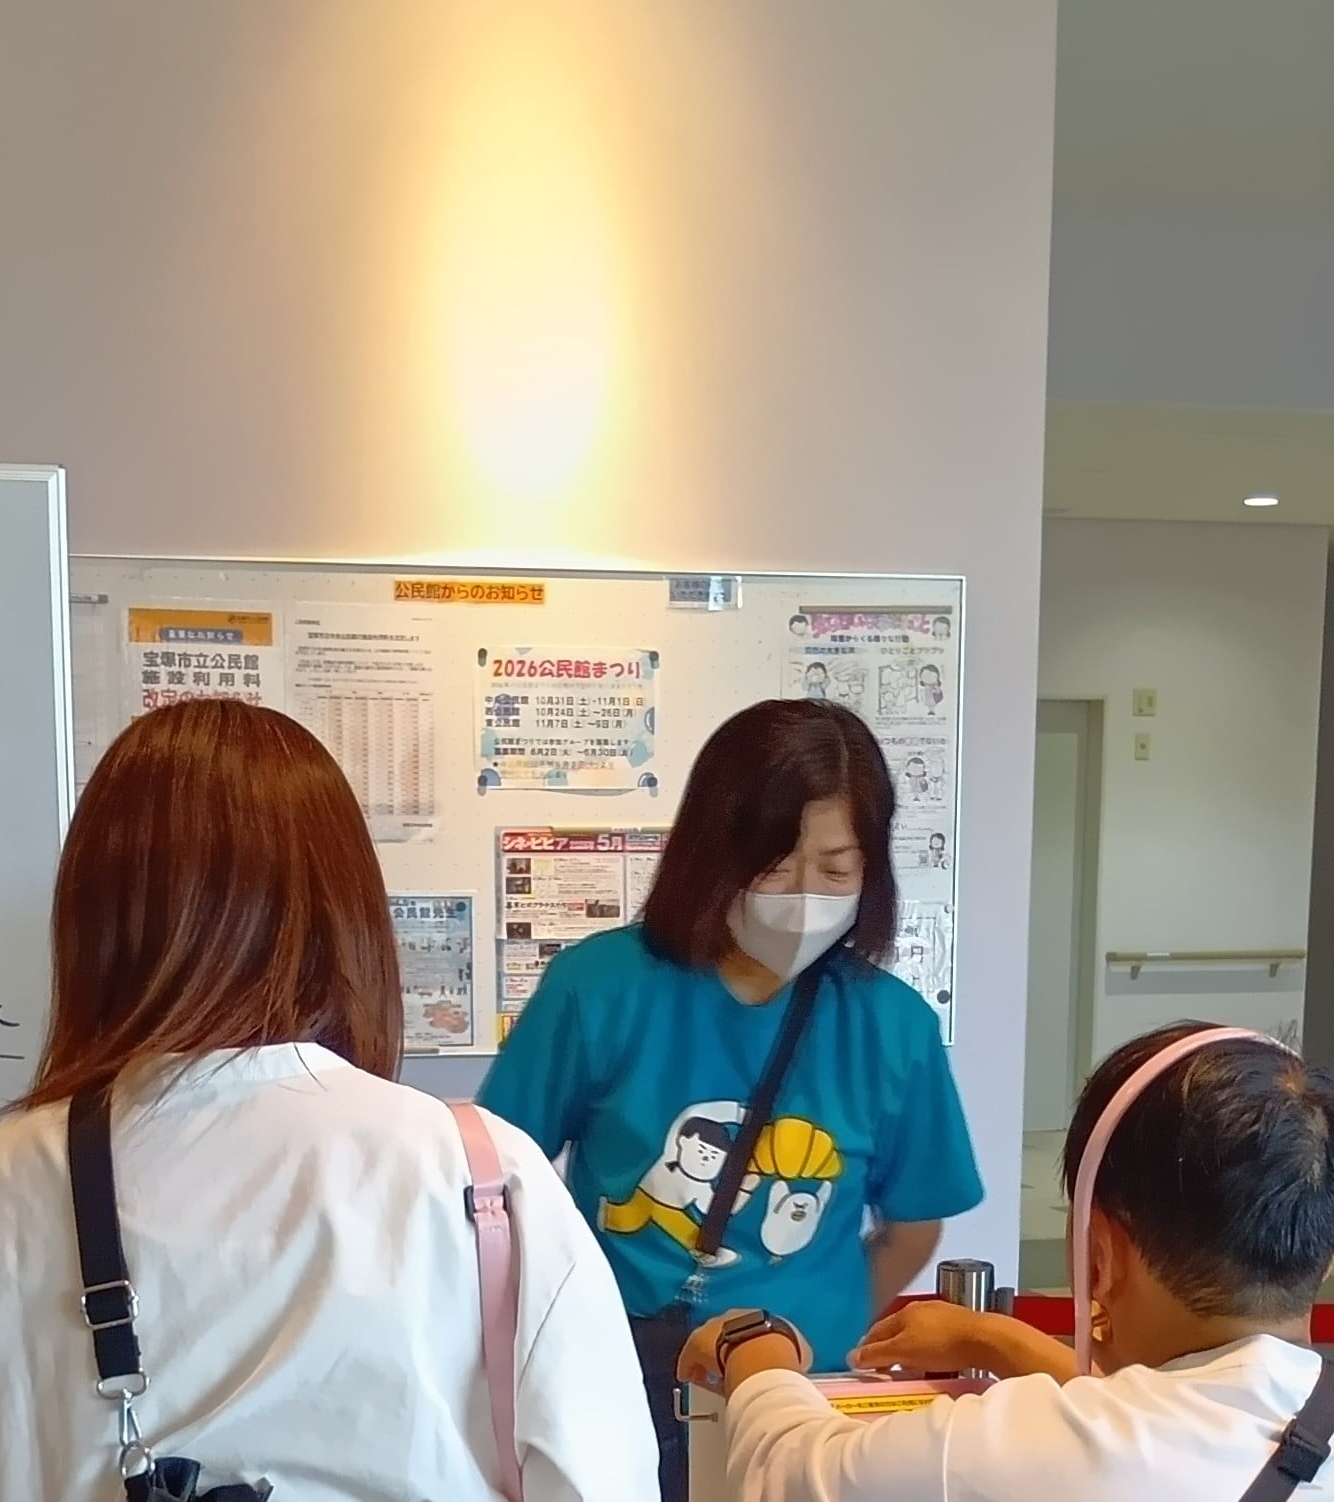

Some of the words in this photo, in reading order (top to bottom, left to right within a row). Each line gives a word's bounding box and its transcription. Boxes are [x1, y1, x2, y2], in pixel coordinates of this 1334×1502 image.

[395, 582, 545, 601] 公民館からのお知らせ
[143, 651, 259, 670] 宝塚市立公民館
[492, 659, 641, 679] 2026公民館まつり
[142, 670, 261, 688] 施設利用料
